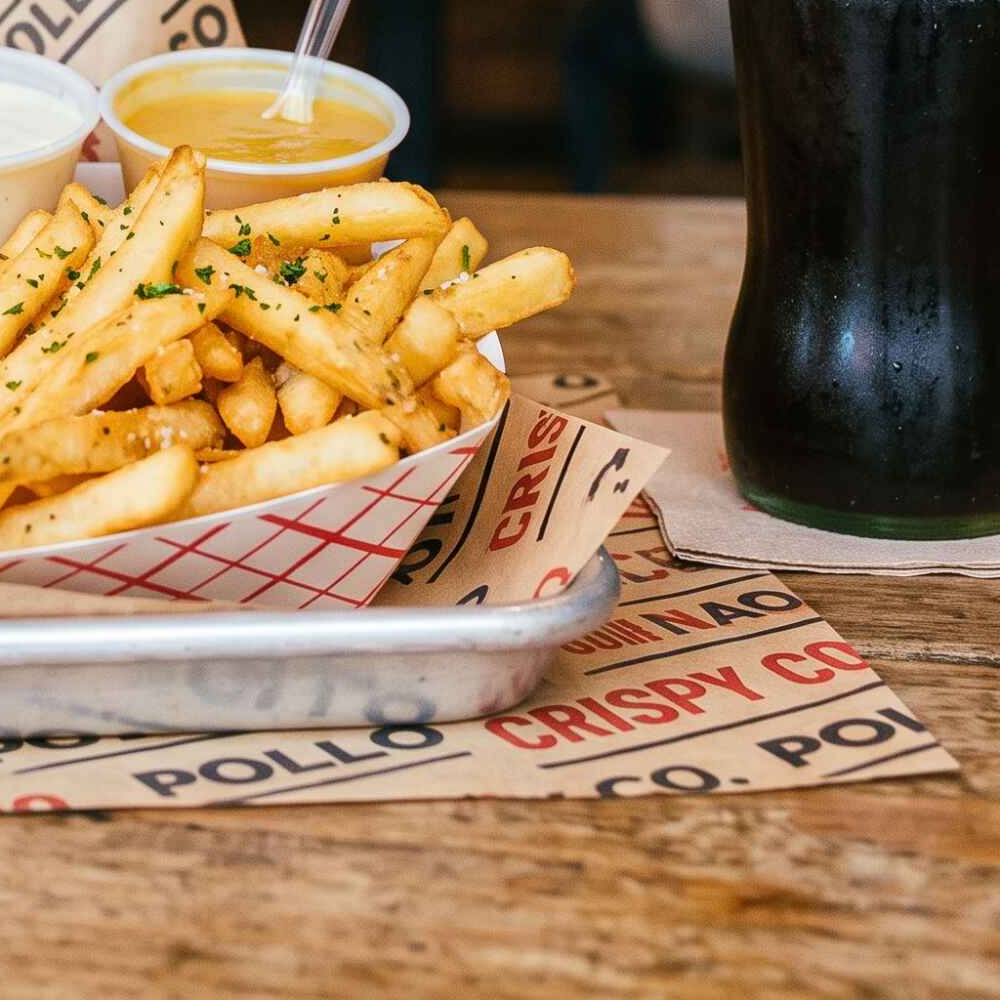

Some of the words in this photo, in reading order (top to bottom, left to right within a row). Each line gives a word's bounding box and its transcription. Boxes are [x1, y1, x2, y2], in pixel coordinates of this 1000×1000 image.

[488, 409, 569, 552] CRIS
[484, 665, 765, 750] CRISPY
[132, 724, 445, 797] POLLO
